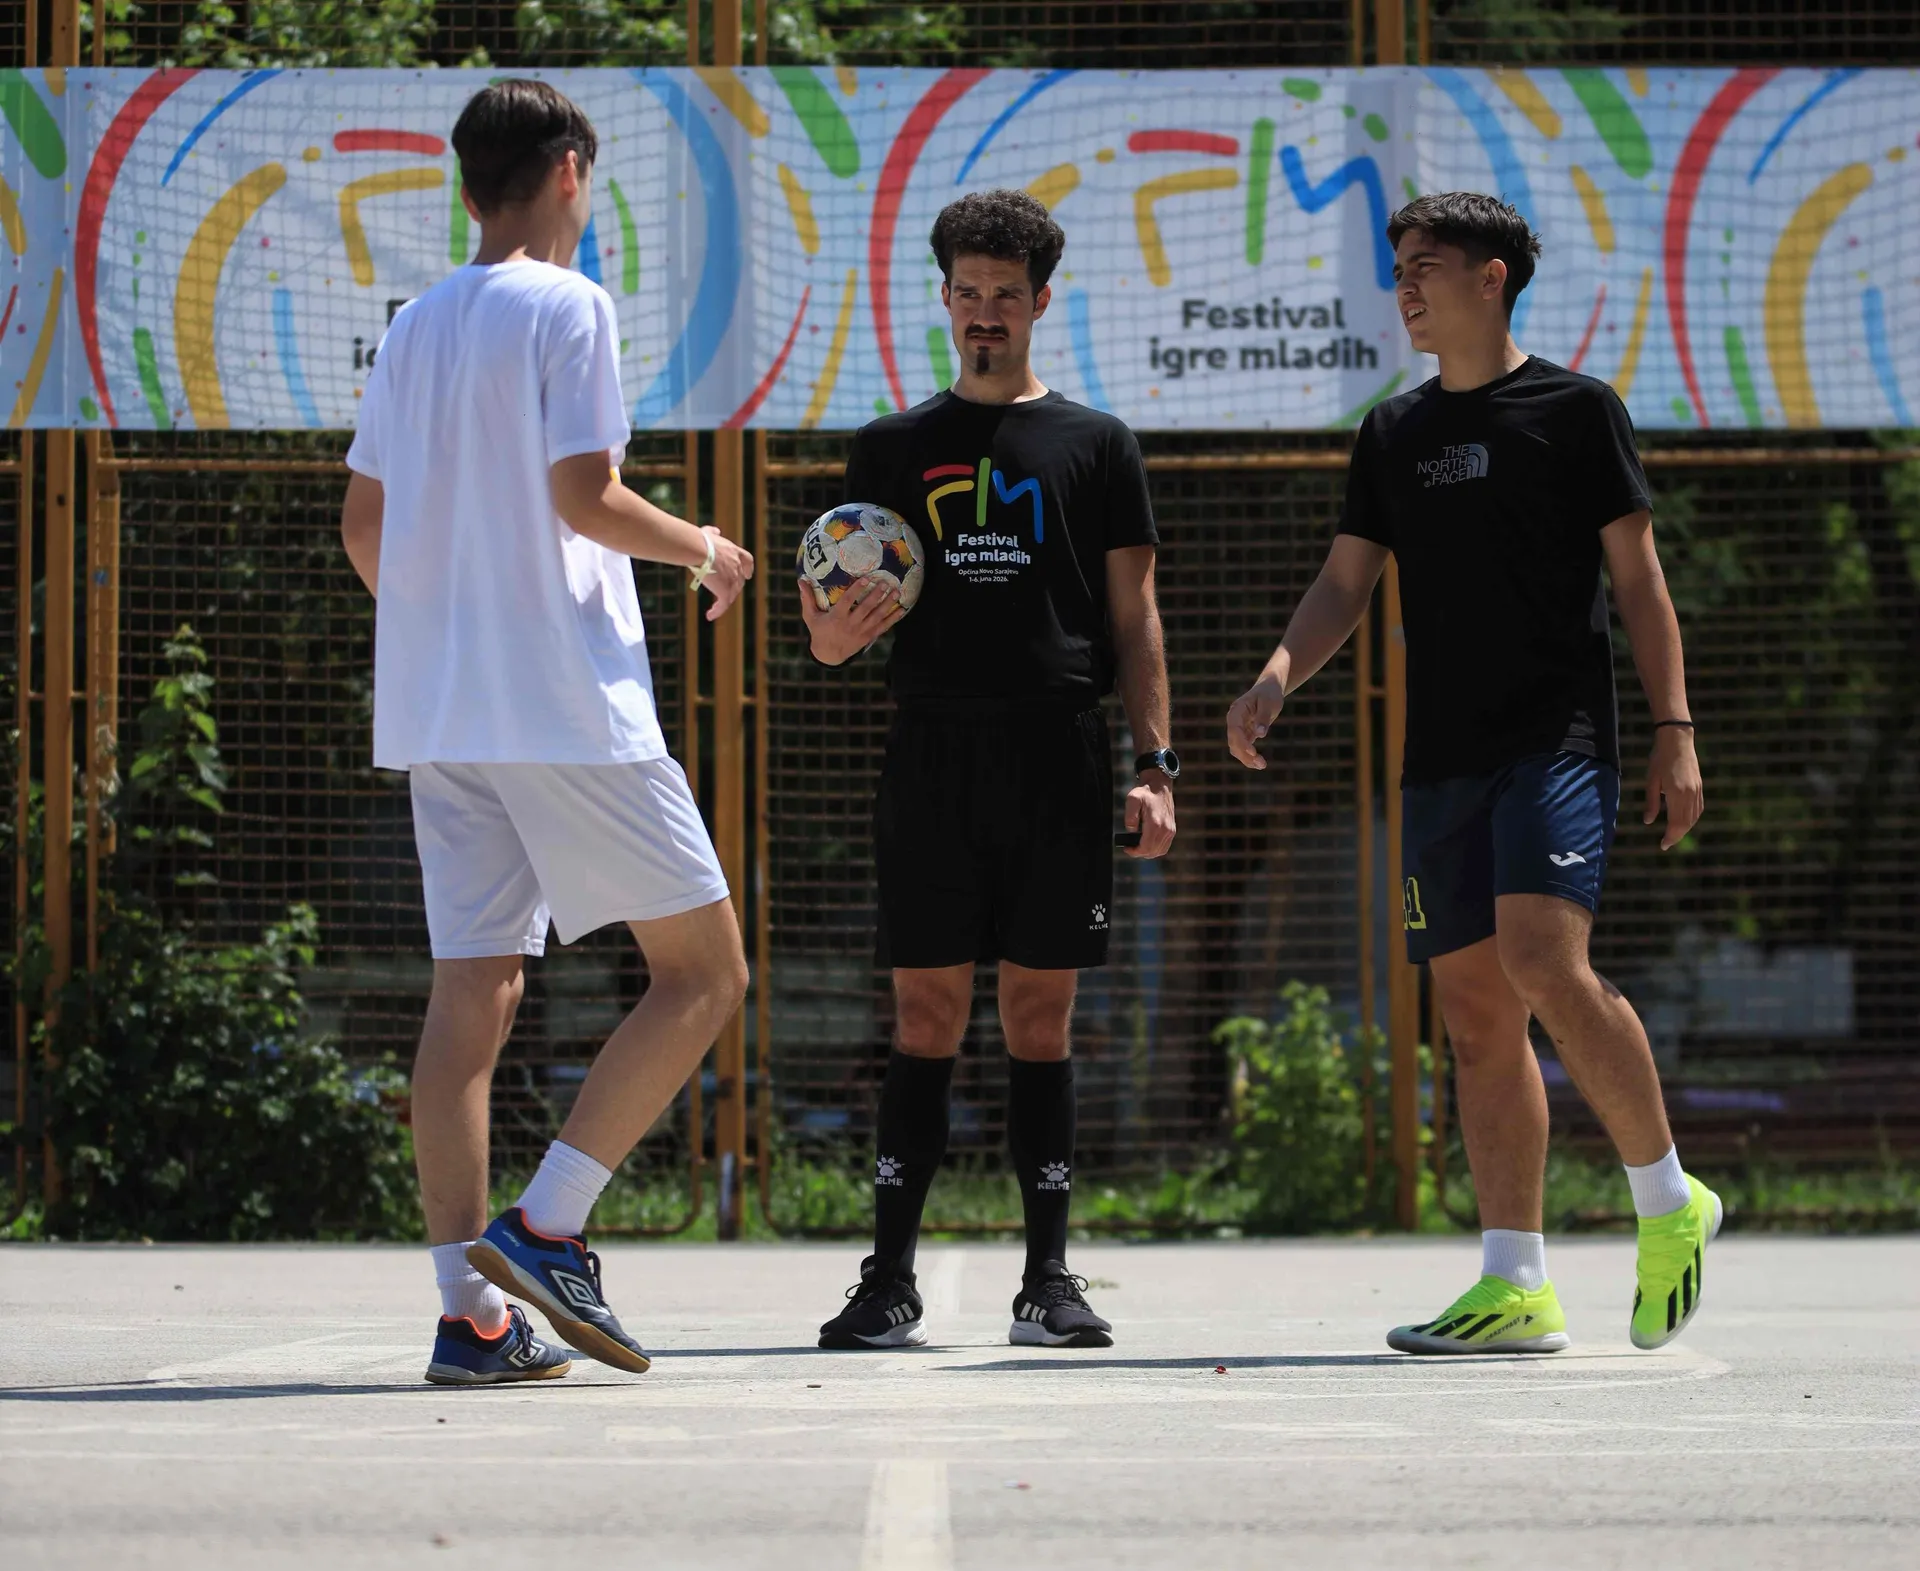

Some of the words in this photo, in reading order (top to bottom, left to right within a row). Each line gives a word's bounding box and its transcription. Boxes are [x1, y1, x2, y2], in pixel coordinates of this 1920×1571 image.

[1181, 297, 1346, 331] Festival
[1149, 337, 1228, 379] igre
[1238, 336, 1378, 371] mladih
[1442, 444, 1469, 458] THE
[1417, 456, 1468, 475] NORTH
[1432, 468, 1466, 486] FACE
[957, 532, 1019, 548] Festival
[944, 549, 977, 566] igre
[980, 548, 1031, 564] mladih
[1089, 922, 1109, 930] KELME
[875, 1176, 903, 1186] KELME
[1037, 1181, 1070, 1191] KELME
